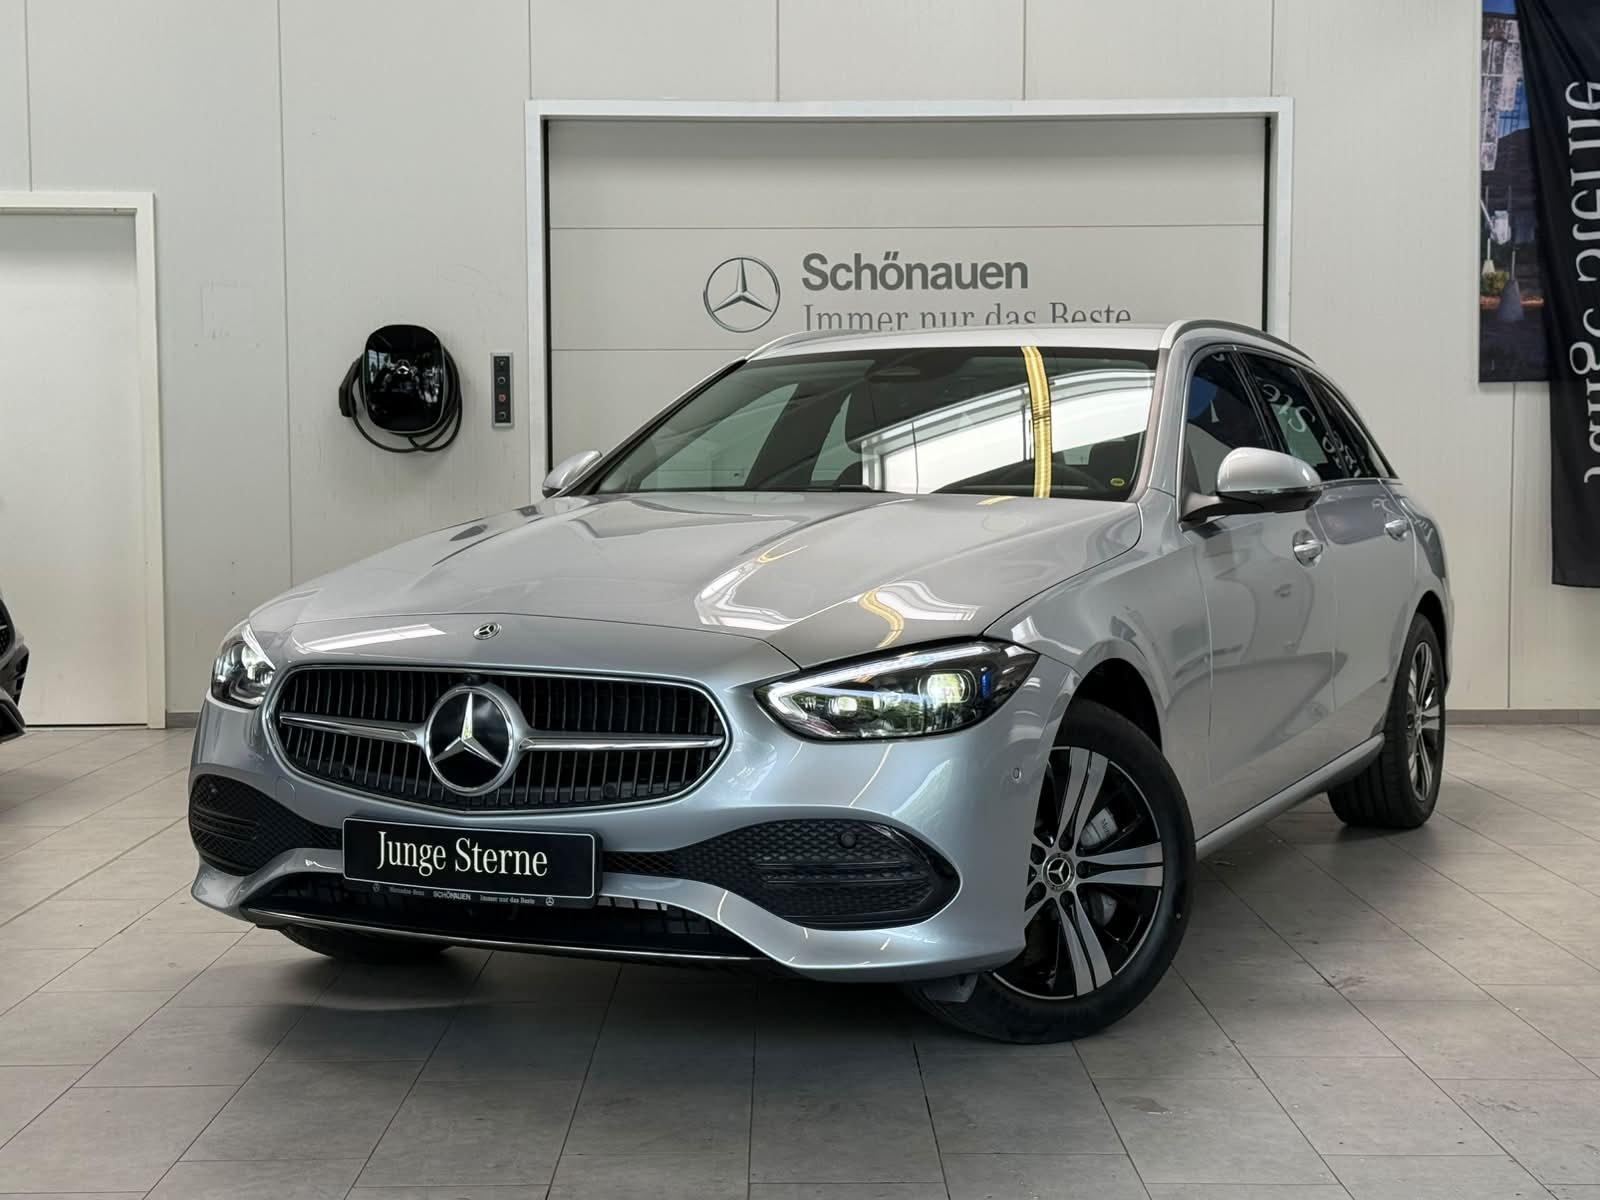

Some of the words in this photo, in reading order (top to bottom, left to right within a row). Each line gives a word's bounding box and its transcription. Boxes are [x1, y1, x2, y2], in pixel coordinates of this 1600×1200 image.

[802, 251, 1029, 291] Schönauen
[803, 304, 909, 331] Immer
[920, 311, 975, 329] nur
[985, 303, 1037, 325] das
[1049, 302, 1132, 323] Beste
[376, 831, 447, 877] Junge
[454, 837, 548, 877] Sterne
